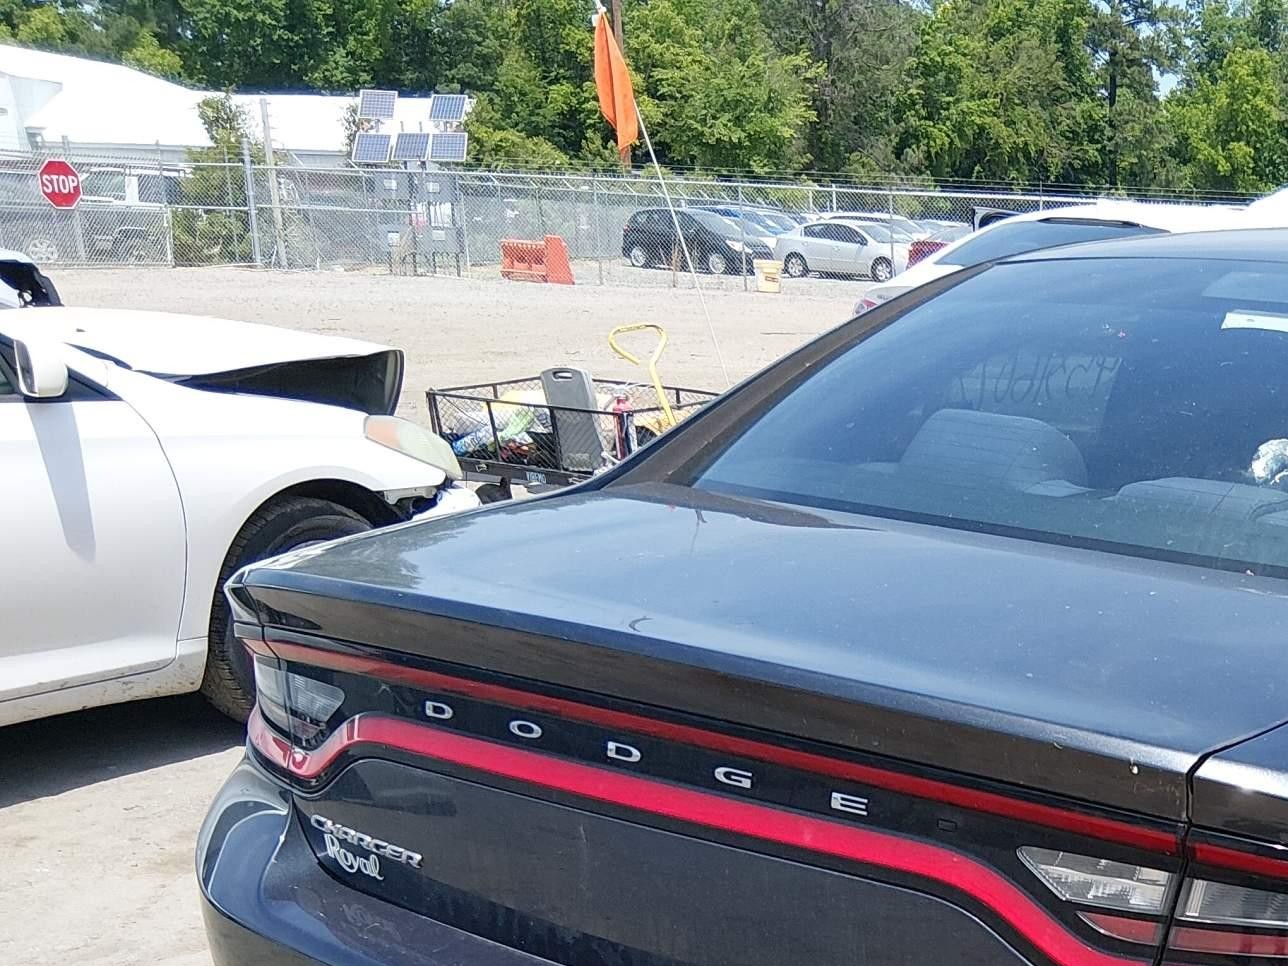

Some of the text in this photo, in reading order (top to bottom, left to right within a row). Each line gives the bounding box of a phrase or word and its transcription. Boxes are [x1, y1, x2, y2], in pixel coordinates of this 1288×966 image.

[42, 174, 78, 194] STOP
[424, 700, 869, 817] DODGE
[310, 814, 423, 869] CHARGER
[323, 833, 385, 881] Royal
